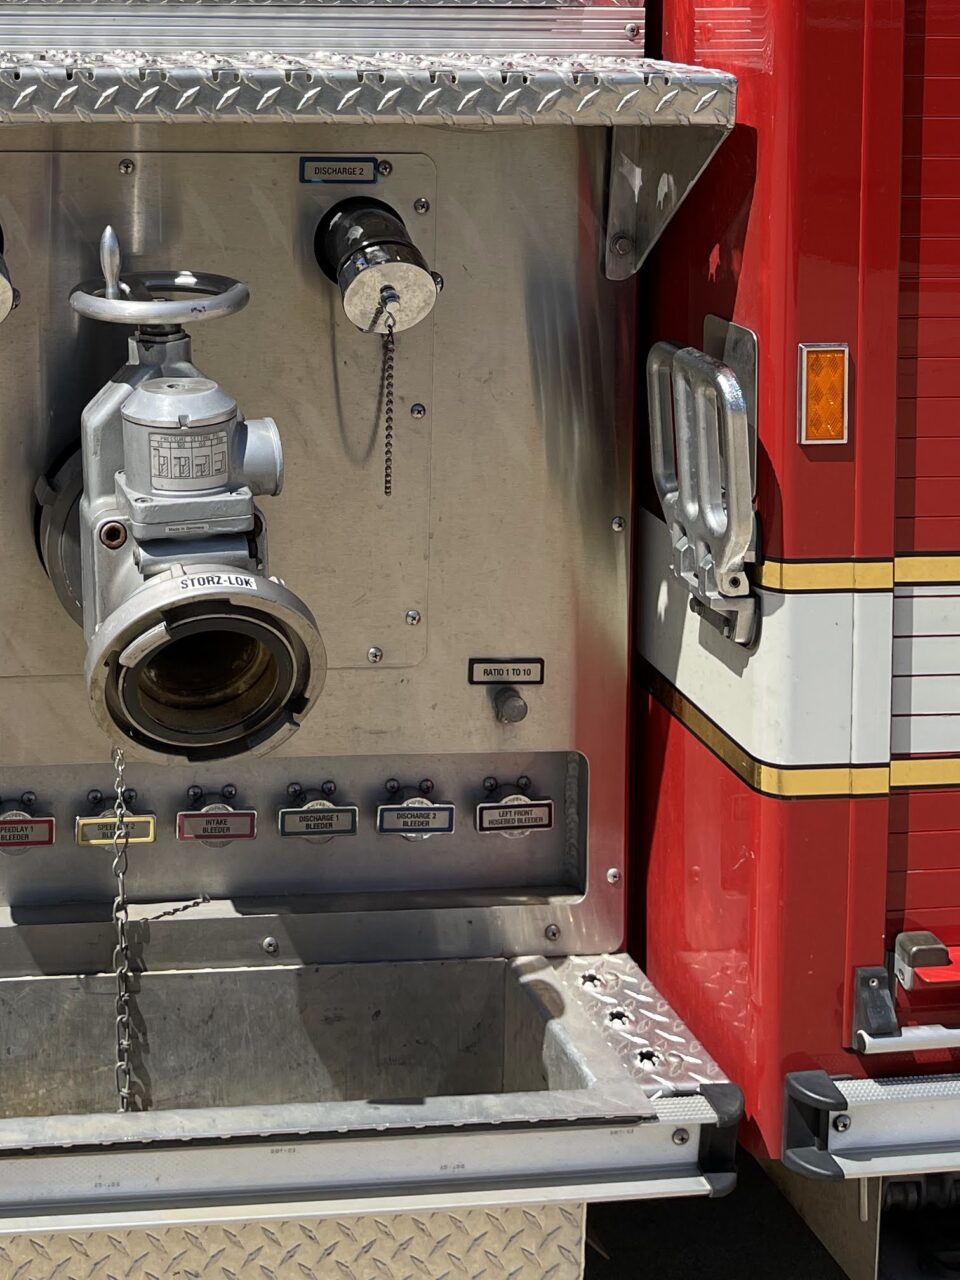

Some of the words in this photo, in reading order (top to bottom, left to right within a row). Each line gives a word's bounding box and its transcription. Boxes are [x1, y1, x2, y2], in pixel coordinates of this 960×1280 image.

[313, 166, 358, 176] DISCHARGE
[358, 167, 364, 176] 2
[180, 575, 253, 590] STORZ-LOK
[483, 668, 504, 676] RATIO
[505, 668, 510, 676] 1
[511, 668, 521, 676] TO
[522, 668, 532, 676] 10
[396, 812, 431, 820] DISCHARGE
[498, 810, 513, 818] LEFT
[513, 809, 534, 817] FRONT
[205, 818, 228, 826] INTAKE
[298, 814, 334, 822] DISCHARGE
[516, 816, 544, 824] BLEEDER
[202, 826, 231, 834] BLEEDER
[305, 822, 333, 830] BLEEDER
[0, 833, 29, 841] BLEEDER
